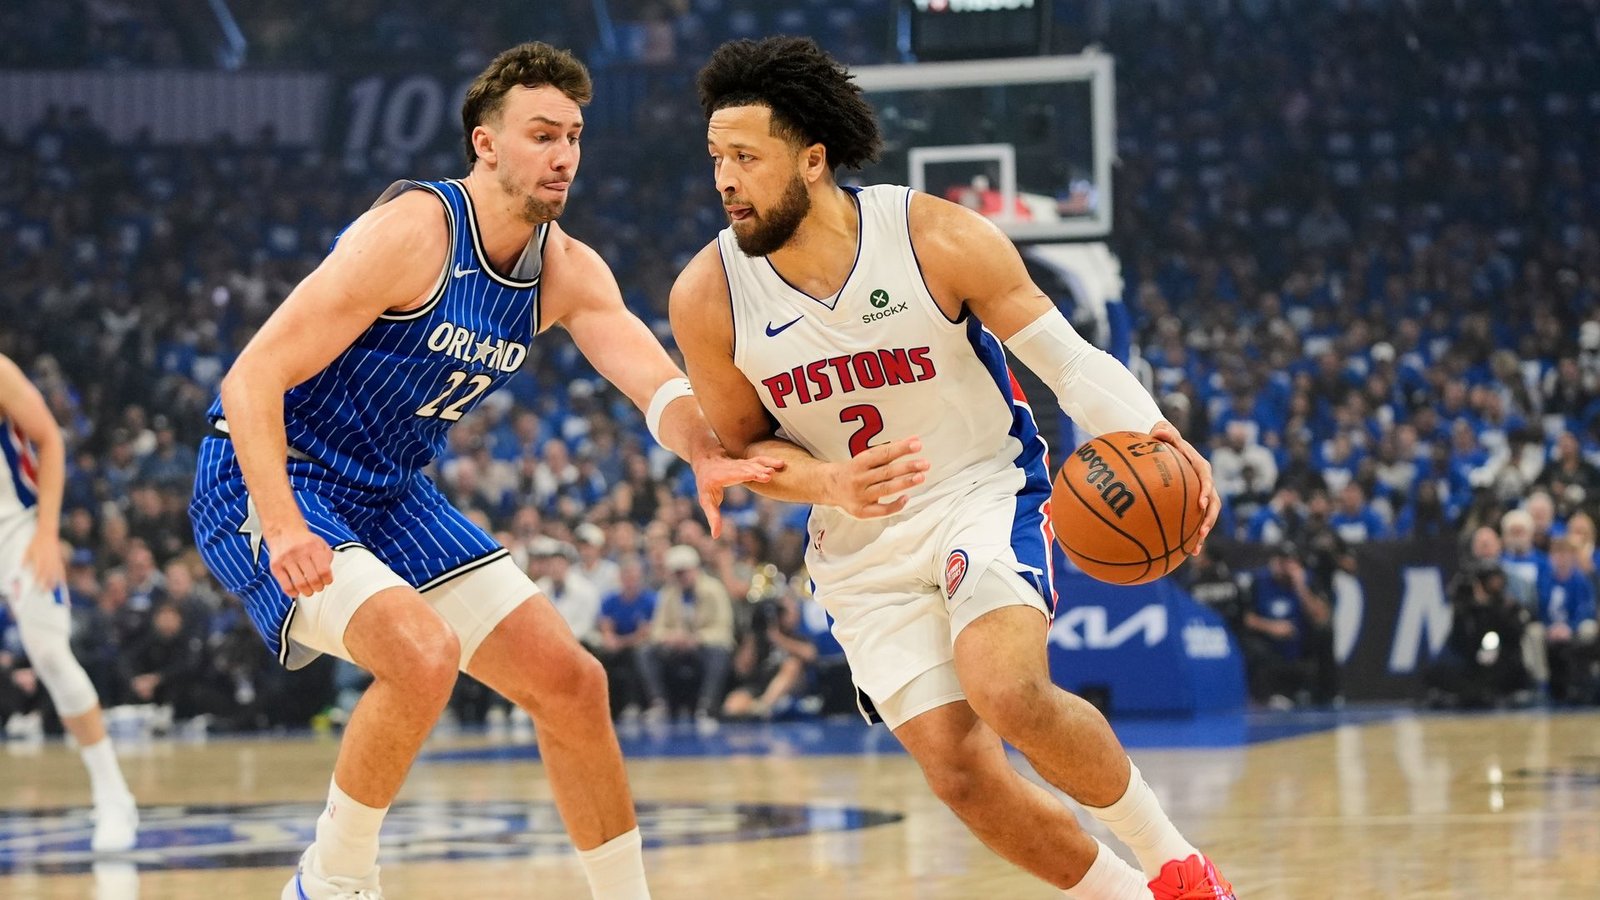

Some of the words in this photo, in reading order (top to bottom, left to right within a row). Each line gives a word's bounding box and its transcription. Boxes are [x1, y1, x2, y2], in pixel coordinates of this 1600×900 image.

[862, 301, 908, 324] StockX
[426, 321, 528, 373] ORLAND
[414, 369, 493, 422] 22
[761, 346, 937, 409] PISTONS
[839, 403, 890, 459] 2
[1076, 442, 1136, 519] Wilson
